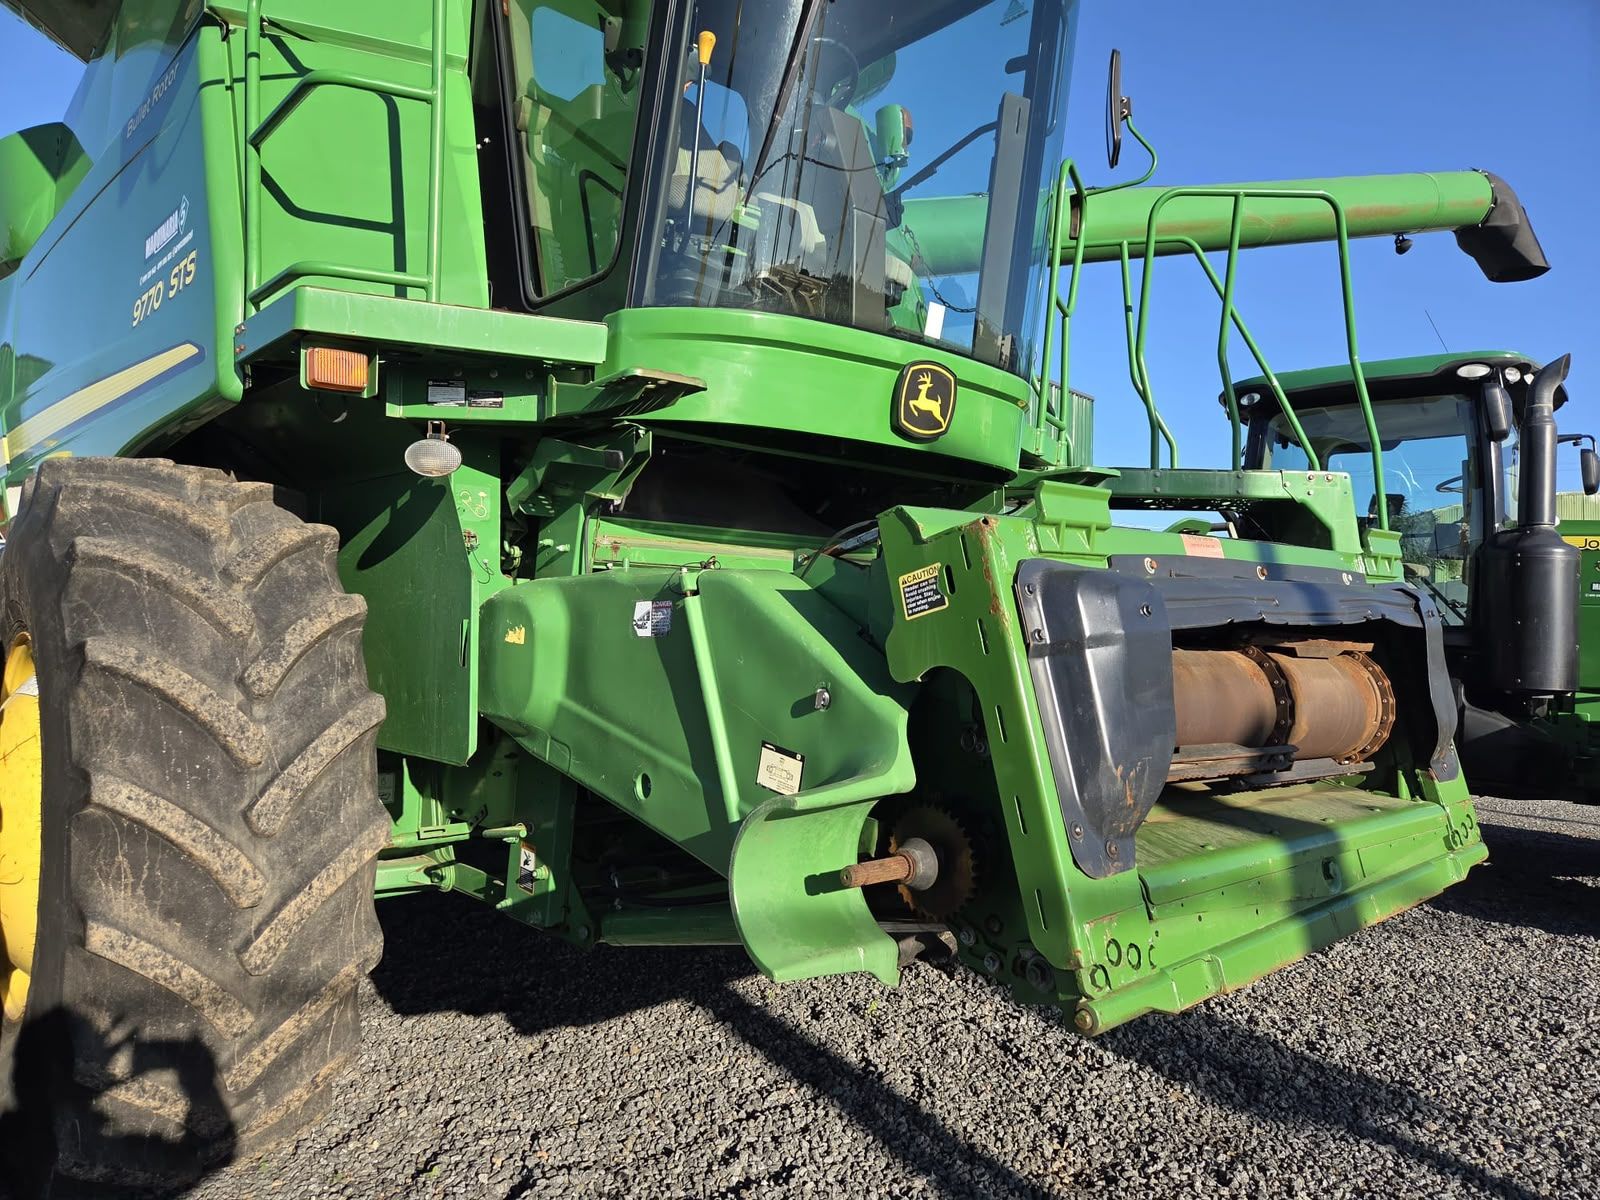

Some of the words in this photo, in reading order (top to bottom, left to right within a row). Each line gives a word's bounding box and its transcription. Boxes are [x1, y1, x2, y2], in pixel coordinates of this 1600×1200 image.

[127, 97, 151, 139] Bullet
[152, 62, 180, 106] Rotor
[132, 280, 165, 327] 9770
[168, 248, 198, 300] STS
